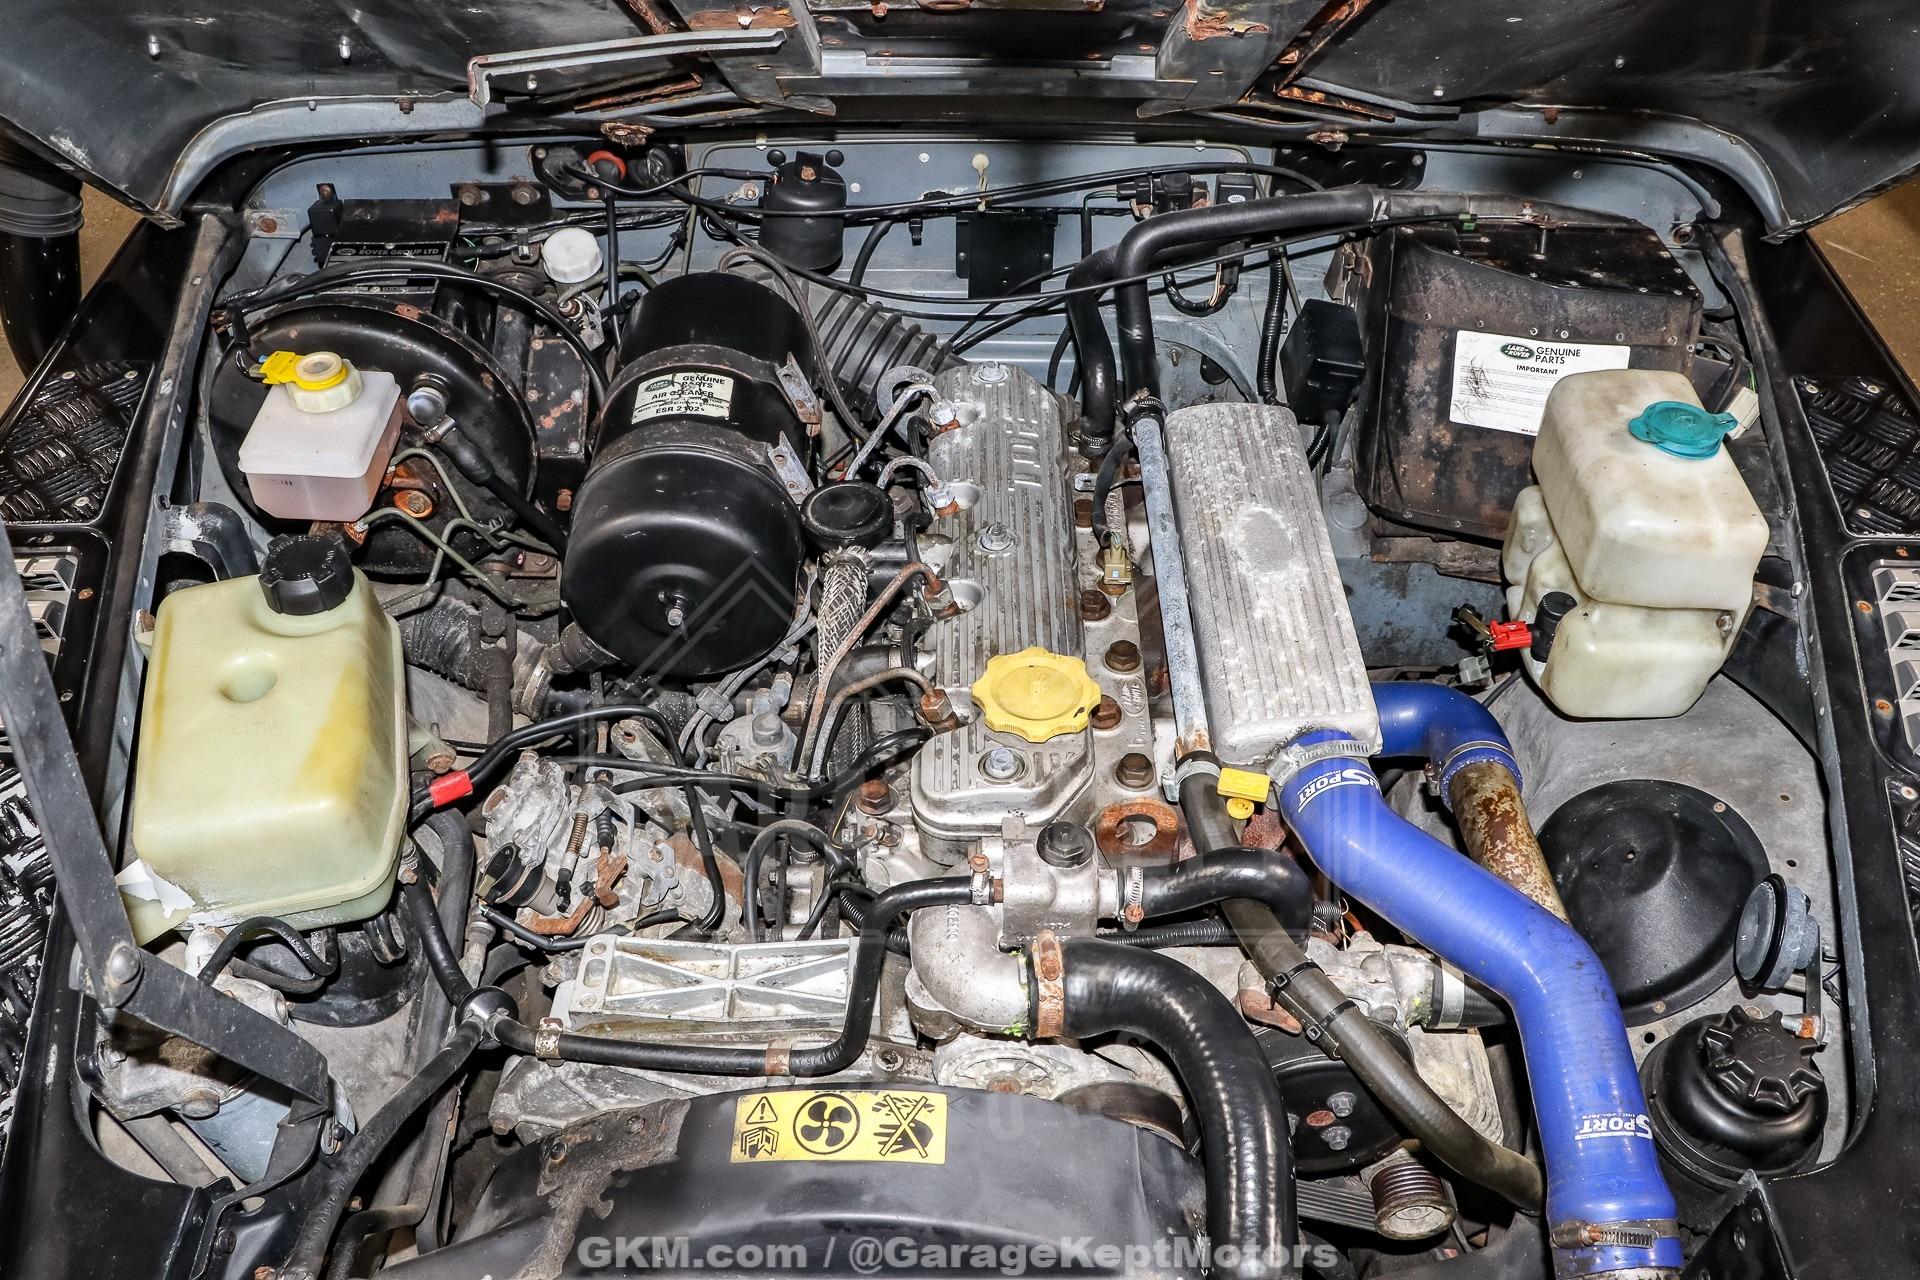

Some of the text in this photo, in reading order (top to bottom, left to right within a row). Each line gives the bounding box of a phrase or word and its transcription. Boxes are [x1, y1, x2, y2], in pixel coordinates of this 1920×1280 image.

[1506, 344, 1525, 352] LAND
[1536, 346, 1582, 357] GENUINE
[1508, 350, 1531, 358] ROVER
[1535, 354, 1566, 365] PARTS
[1515, 364, 1559, 375] IMPORTANT
[682, 375, 726, 385] GENUINE
[681, 381, 713, 389] PARTS
[651, 392, 667, 400] AIR
[655, 406, 674, 414] ESR
